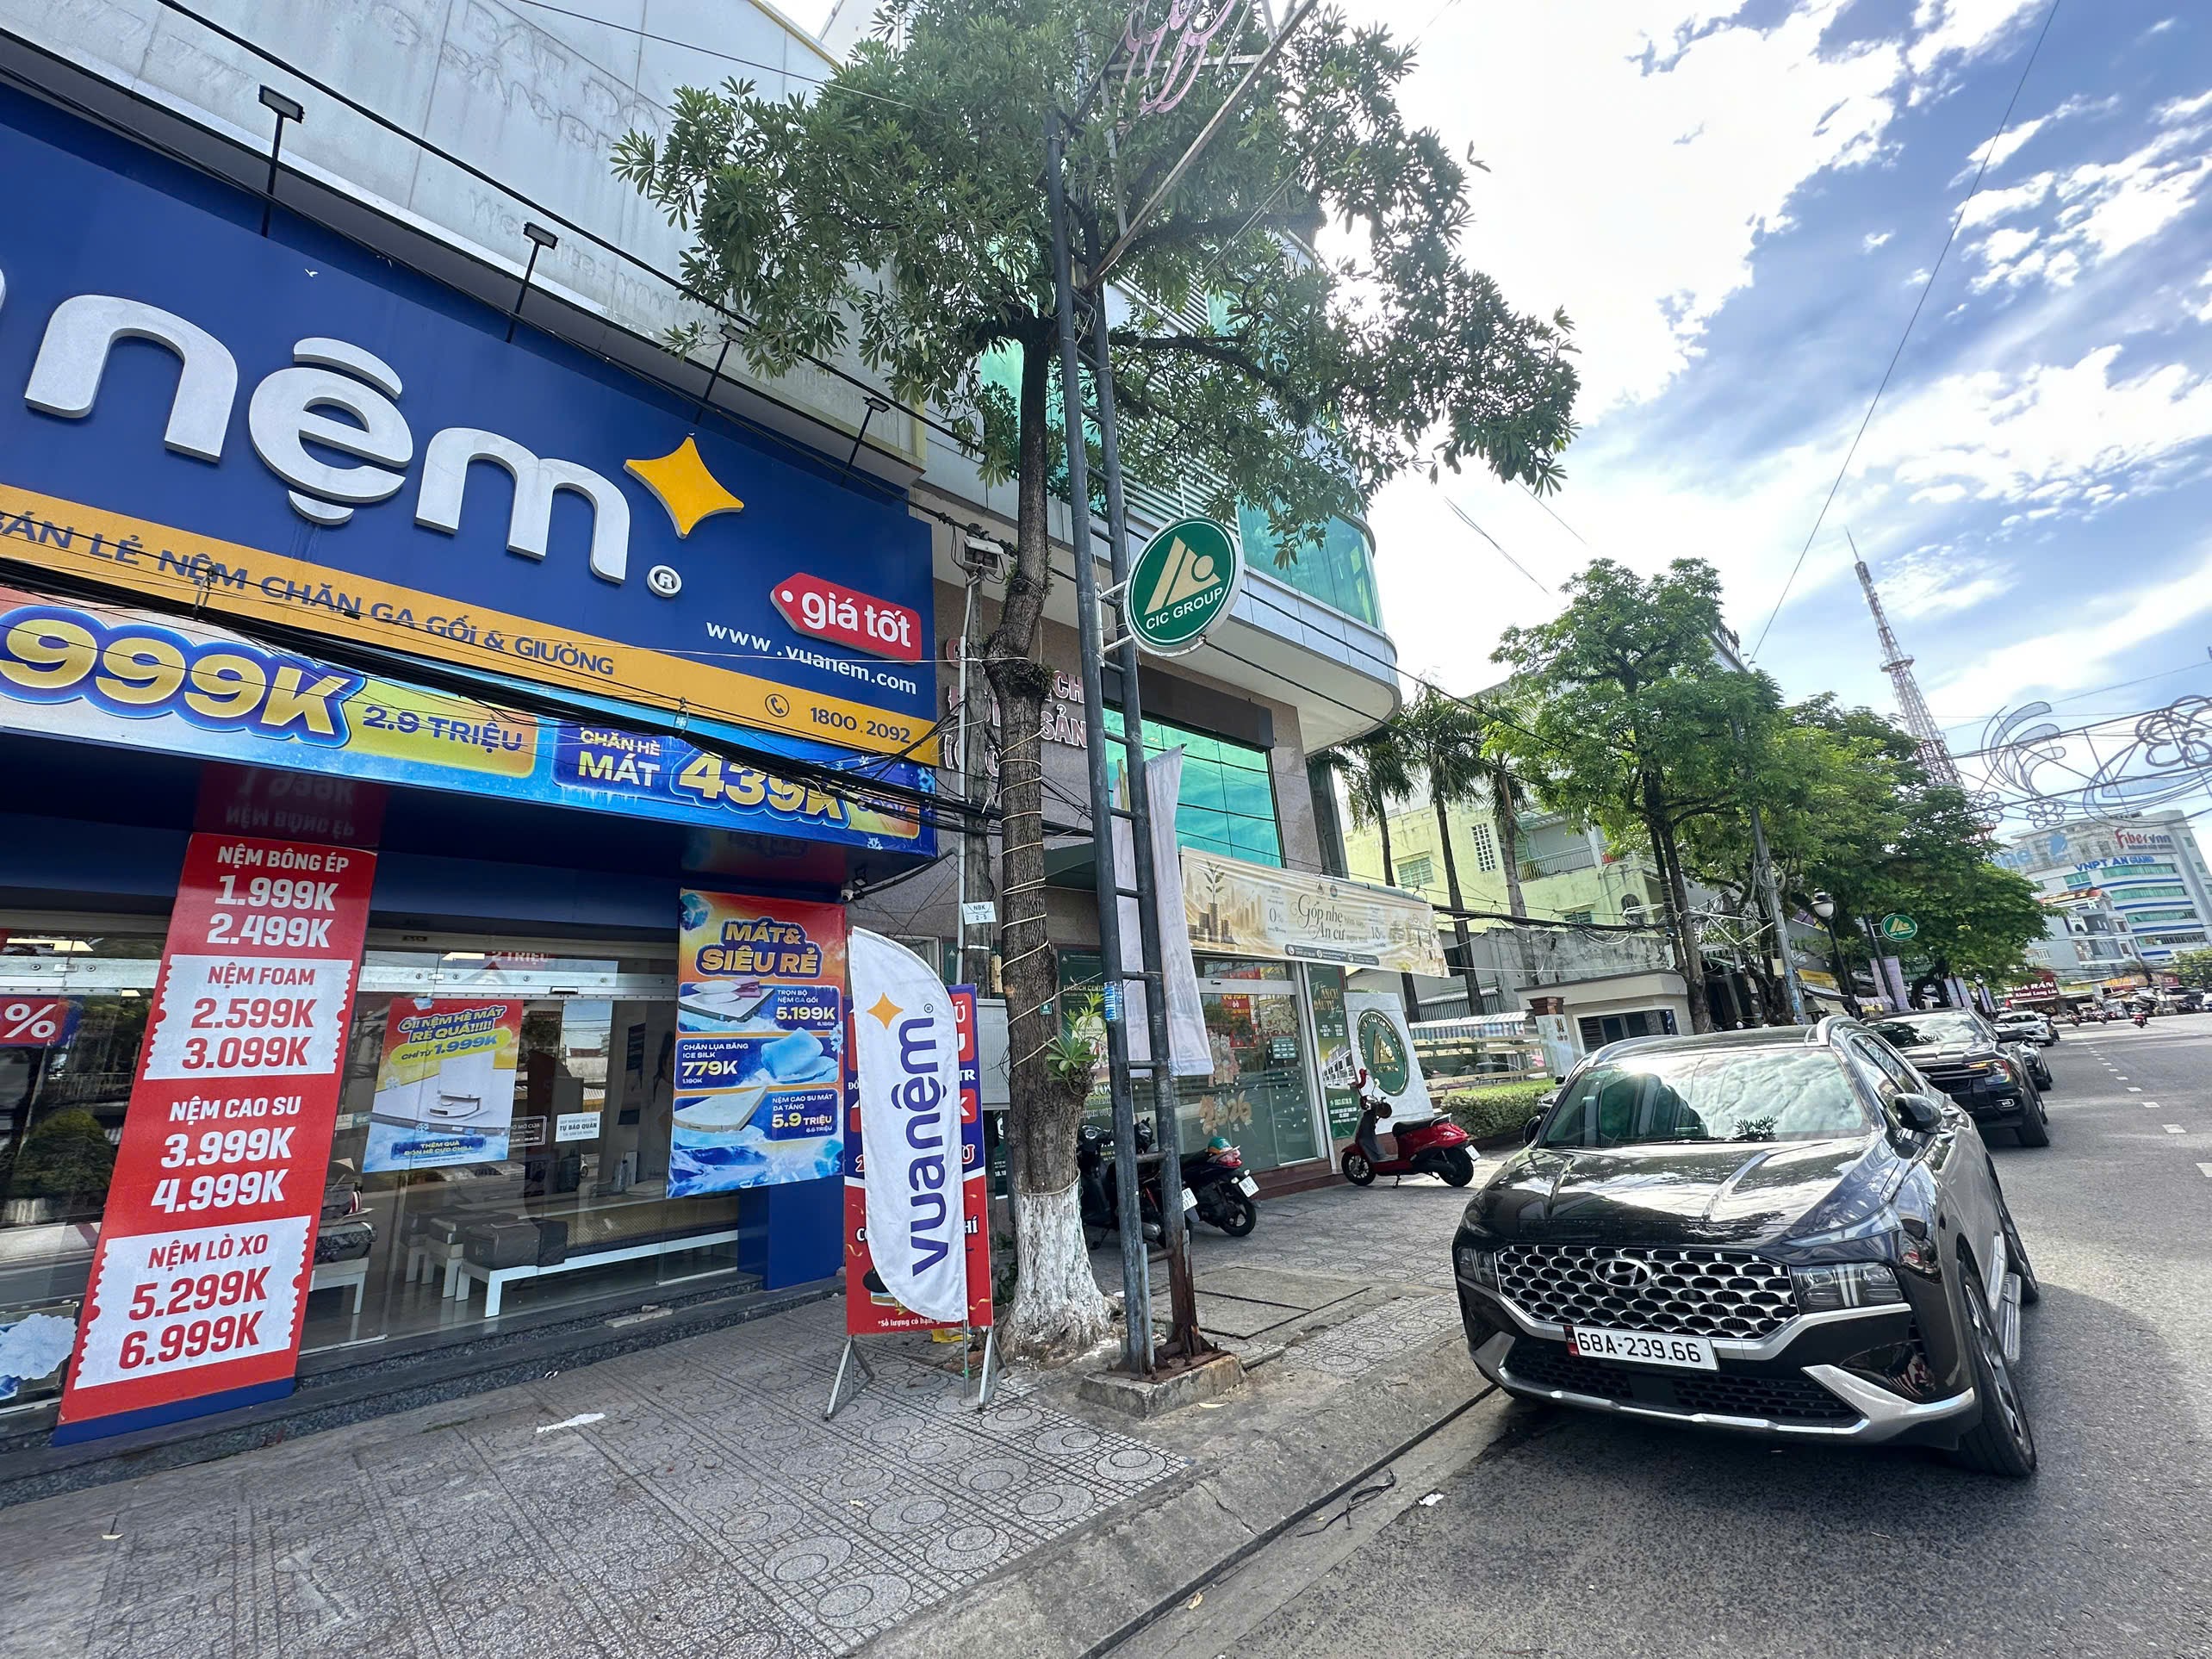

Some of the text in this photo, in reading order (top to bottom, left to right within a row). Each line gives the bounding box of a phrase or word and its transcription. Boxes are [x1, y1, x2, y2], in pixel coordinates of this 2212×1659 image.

[0, 268, 631, 584] nệm
[89, 533, 143, 565] LẺ
[158, 551, 248, 590] NỆM
[260, 575, 362, 615] CHĂN
[370, 602, 415, 629] GA
[426, 615, 476, 645] GỐI
[483, 631, 505, 650] &
[514, 637, 614, 674] GIƯỜNG
[801, 588, 911, 649] giá tốt
[1146, 587, 1223, 630] CIC GROUP
[428, 715, 523, 753] TRIỆU
[581, 728, 661, 756] CHĂN HÈ
[578, 750, 662, 787] MÁT
[217, 843, 349, 873] NỆM BÔNG ÉP
[2074, 859, 2107, 873] VNPT
[2113, 856, 2129, 866] AN
[215, 875, 339, 911] 1.999K
[1290, 894, 1323, 929] Góp
[1327, 905, 1343, 928] nhẹ
[207, 913, 333, 948] 2.499K
[1308, 922, 1331, 939] An
[1333, 927, 1345, 941] cư
[208, 962, 315, 989] NỆM FOAM
[701, 945, 817, 974] SIÊU RẺ
[2030, 980, 2054, 990] RÁN
[190, 997, 317, 1029] 2.599K
[422, 1014, 452, 1028] NỆM
[454, 1010, 472, 1023] HÈ
[473, 1006, 504, 1020] MÁT
[776, 1006, 836, 1020] 5.199K
[411, 1028, 432, 1042] RẺ
[433, 1034, 498, 1055] 1.999K
[182, 1036, 312, 1069] 3.099K
[681, 1060, 738, 1077] 779K
[169, 1096, 301, 1125] NỆM CAO SU
[772, 1112, 832, 1128] 5.9 TRIỆU
[160, 1127, 296, 1168] 3.999K
[151, 1169, 289, 1214] 4.999K
[148, 1233, 269, 1271] NỆM LÒ XO
[129, 1266, 271, 1321] 5.299K
[118, 1310, 264, 1370] 6.999K
